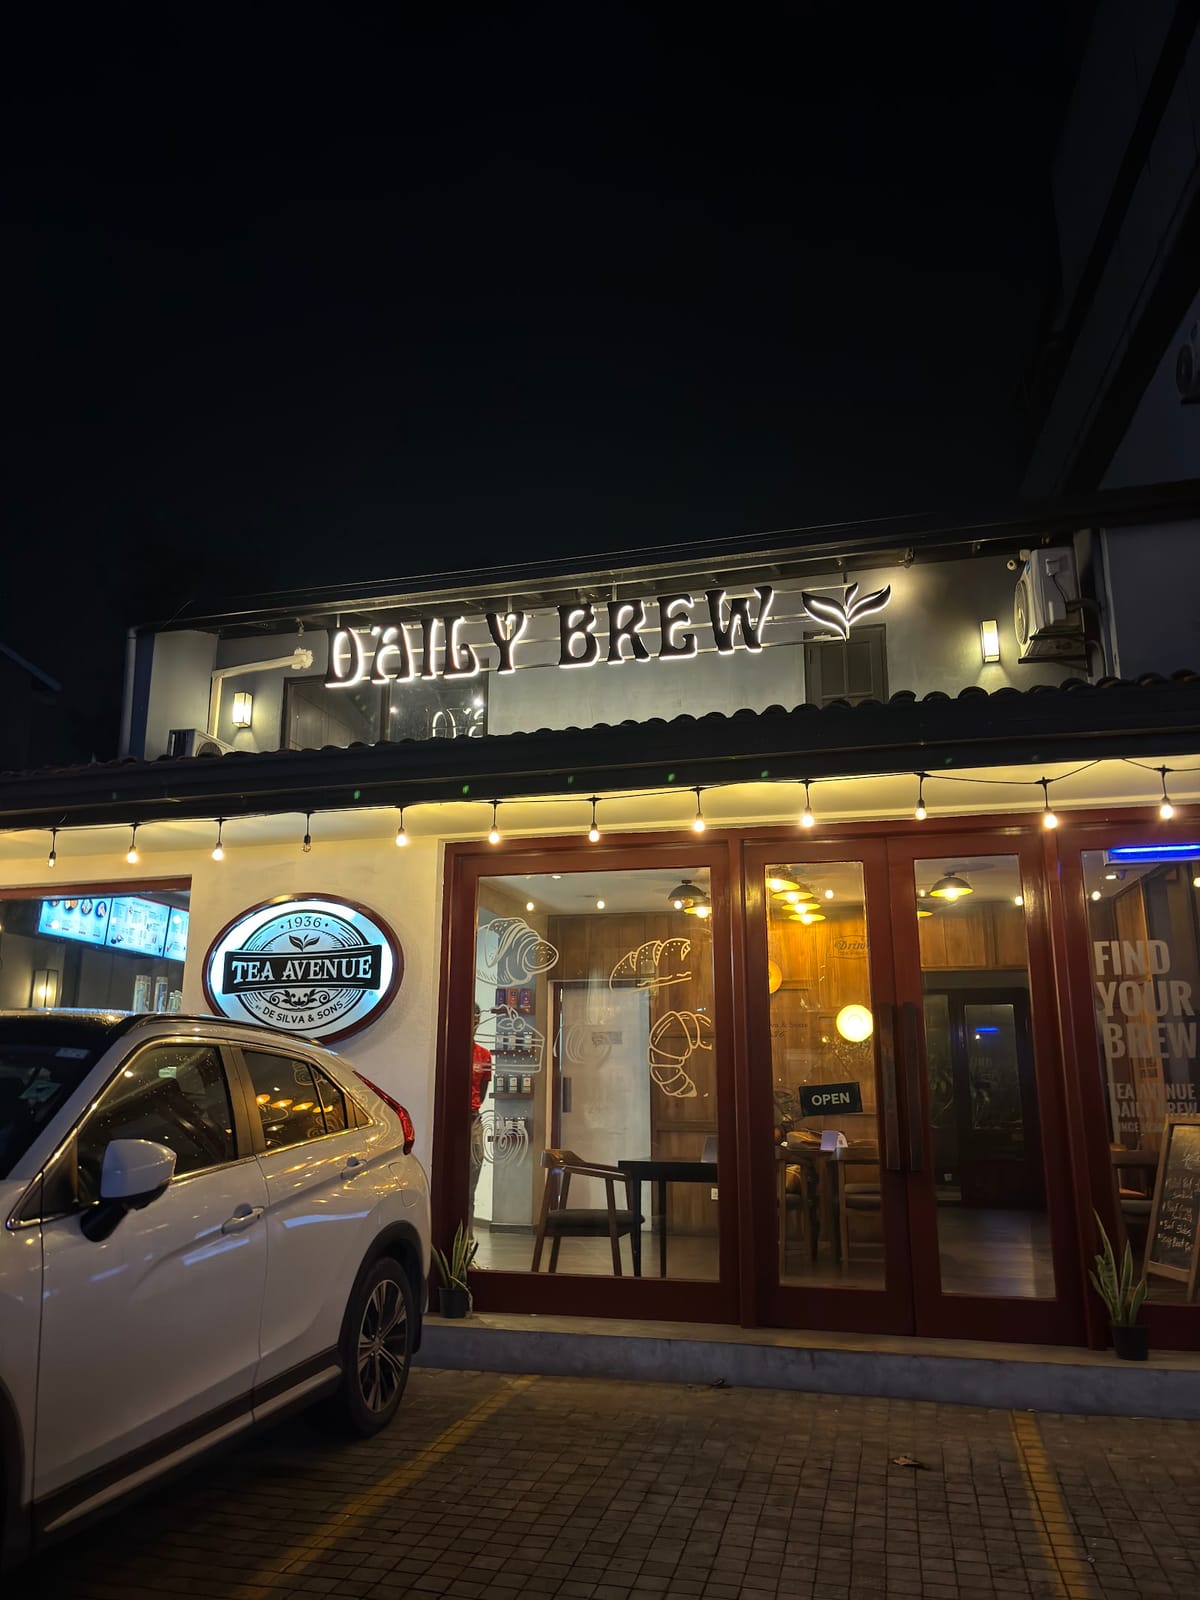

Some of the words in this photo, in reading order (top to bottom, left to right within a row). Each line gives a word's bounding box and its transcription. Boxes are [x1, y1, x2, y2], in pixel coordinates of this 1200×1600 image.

[324, 611, 527, 688] DAILY
[556, 585, 774, 668] BREW
[286, 916, 321, 930] 1936
[231, 960, 275, 984] TEA
[281, 954, 373, 980] AVENUE
[1093, 940, 1171, 976] FIND
[262, 1006, 276, 1019] DE
[276, 1013, 305, 1024] SILVA
[307, 1014, 315, 1023] &
[317, 1000, 344, 1020] SONS
[1095, 980, 1196, 1018] YOUR
[1103, 1022, 1198, 1060] BREW
[811, 1092, 850, 1106] OPEN
